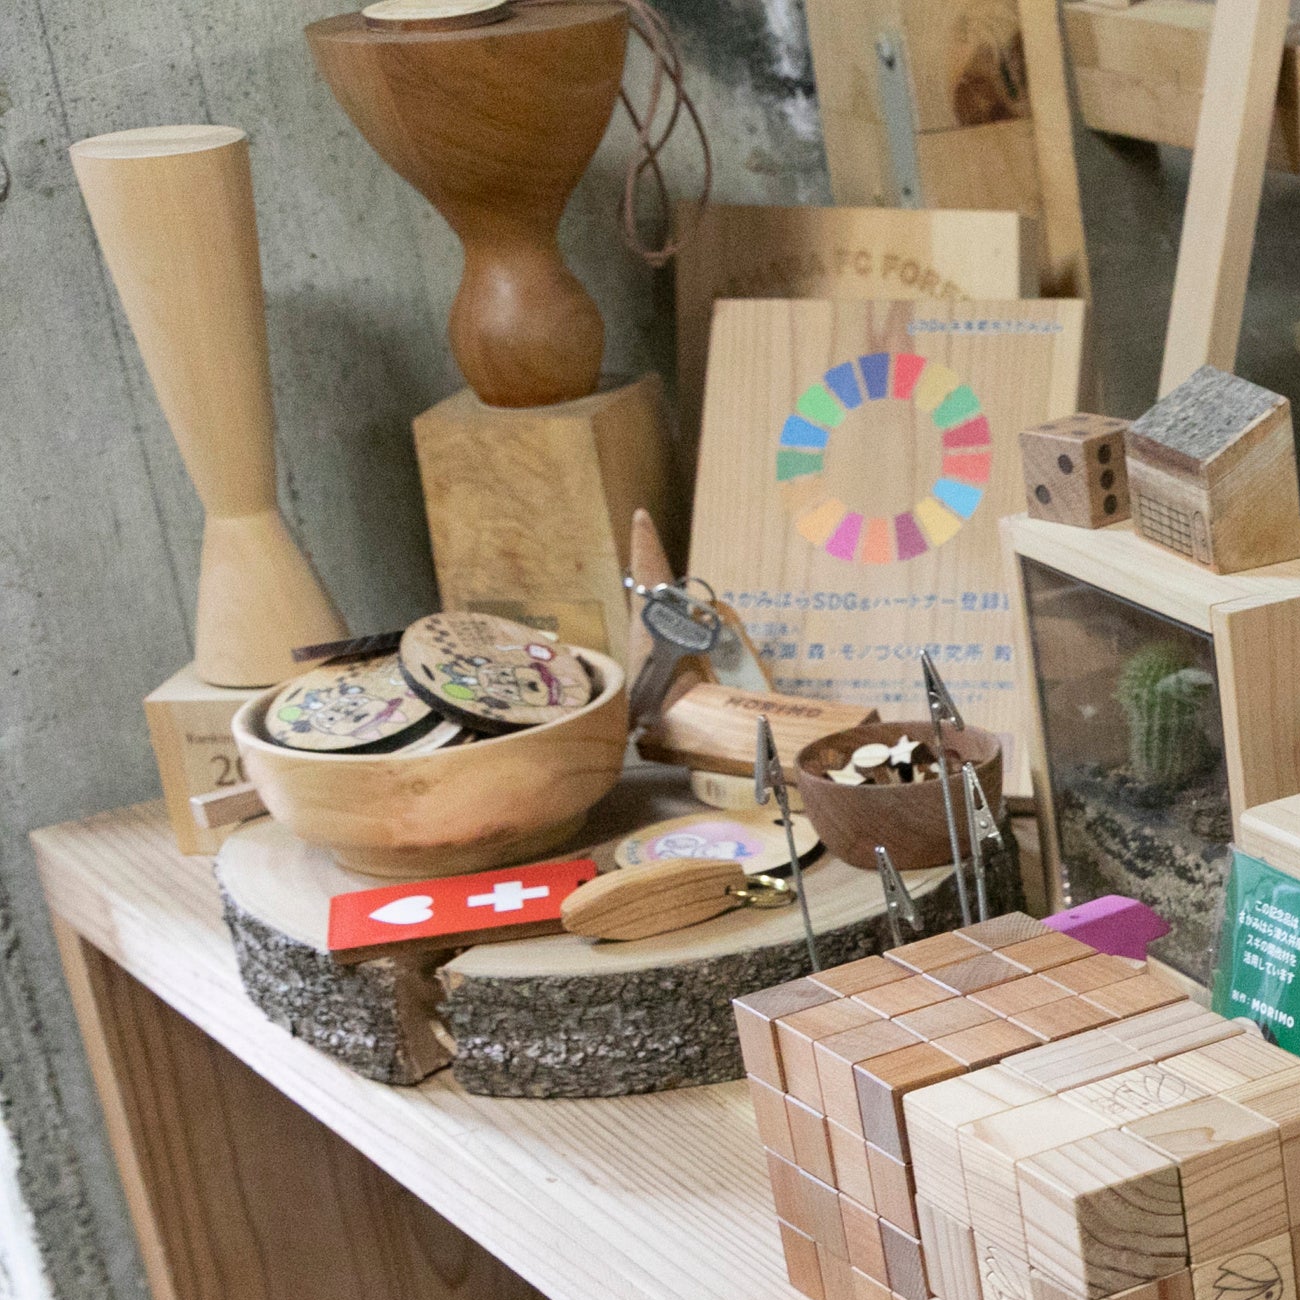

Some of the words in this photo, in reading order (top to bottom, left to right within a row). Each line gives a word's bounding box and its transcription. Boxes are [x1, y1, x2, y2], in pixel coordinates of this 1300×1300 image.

[1254, 900, 1299, 930] この記念品は
[1242, 950, 1295, 985] 活用しています
